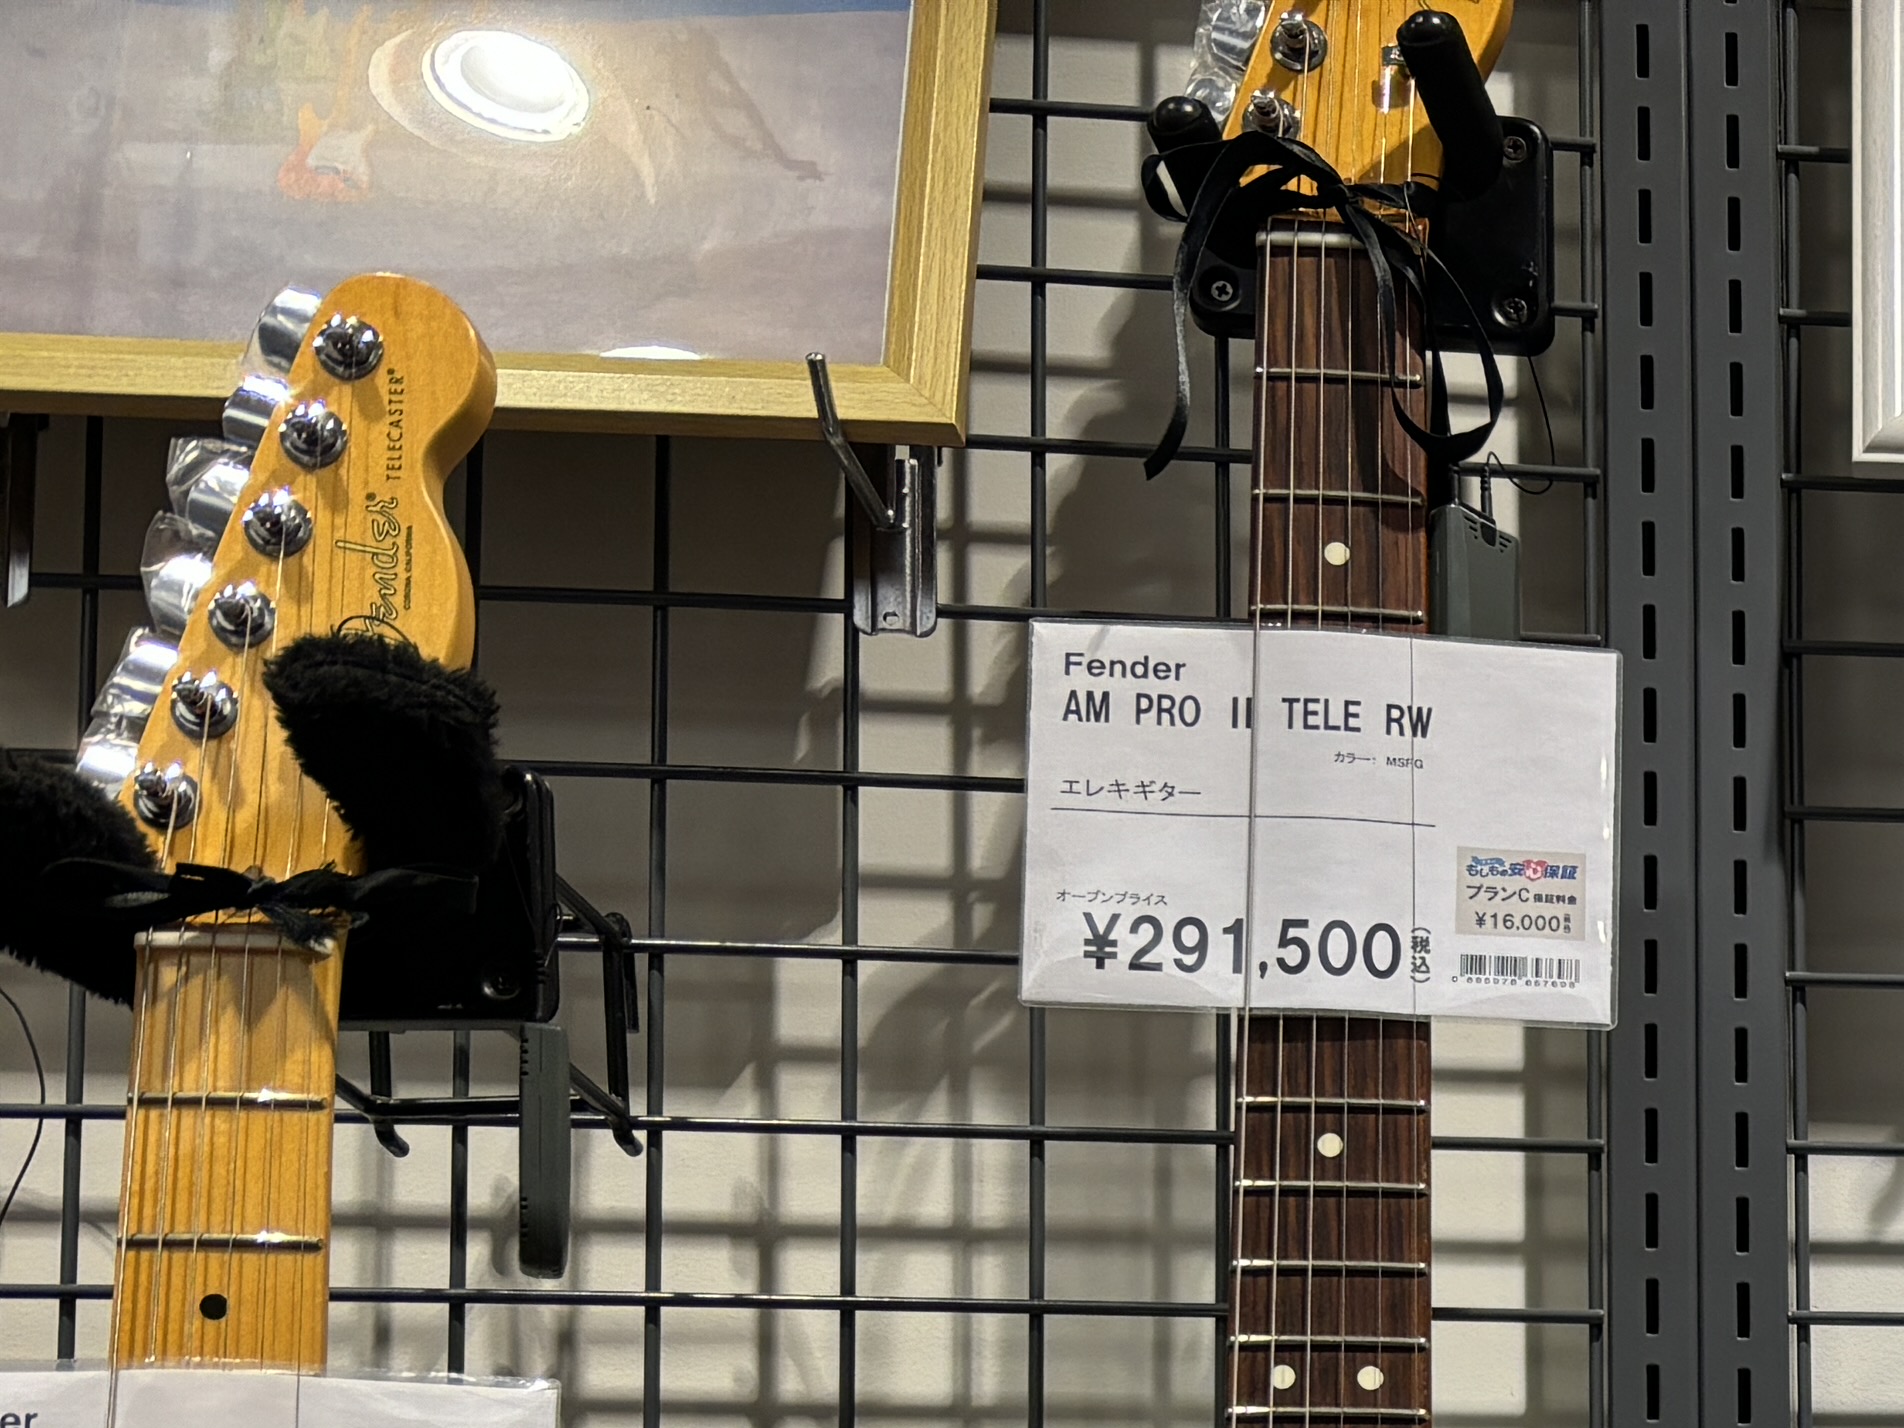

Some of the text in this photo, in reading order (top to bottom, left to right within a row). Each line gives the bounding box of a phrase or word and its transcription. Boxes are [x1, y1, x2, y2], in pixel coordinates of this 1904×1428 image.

[1064, 652, 1186, 682] Fender
[1063, 690, 1110, 723] AM
[1136, 693, 1201, 728] PRO
[1282, 698, 1362, 733] TELE
[1386, 703, 1432, 738] RW
[1060, 779, 1202, 802] エレキギター
[1475, 911, 1560, 933] ¥16,000
[1083, 911, 1402, 980] ¥291,500
